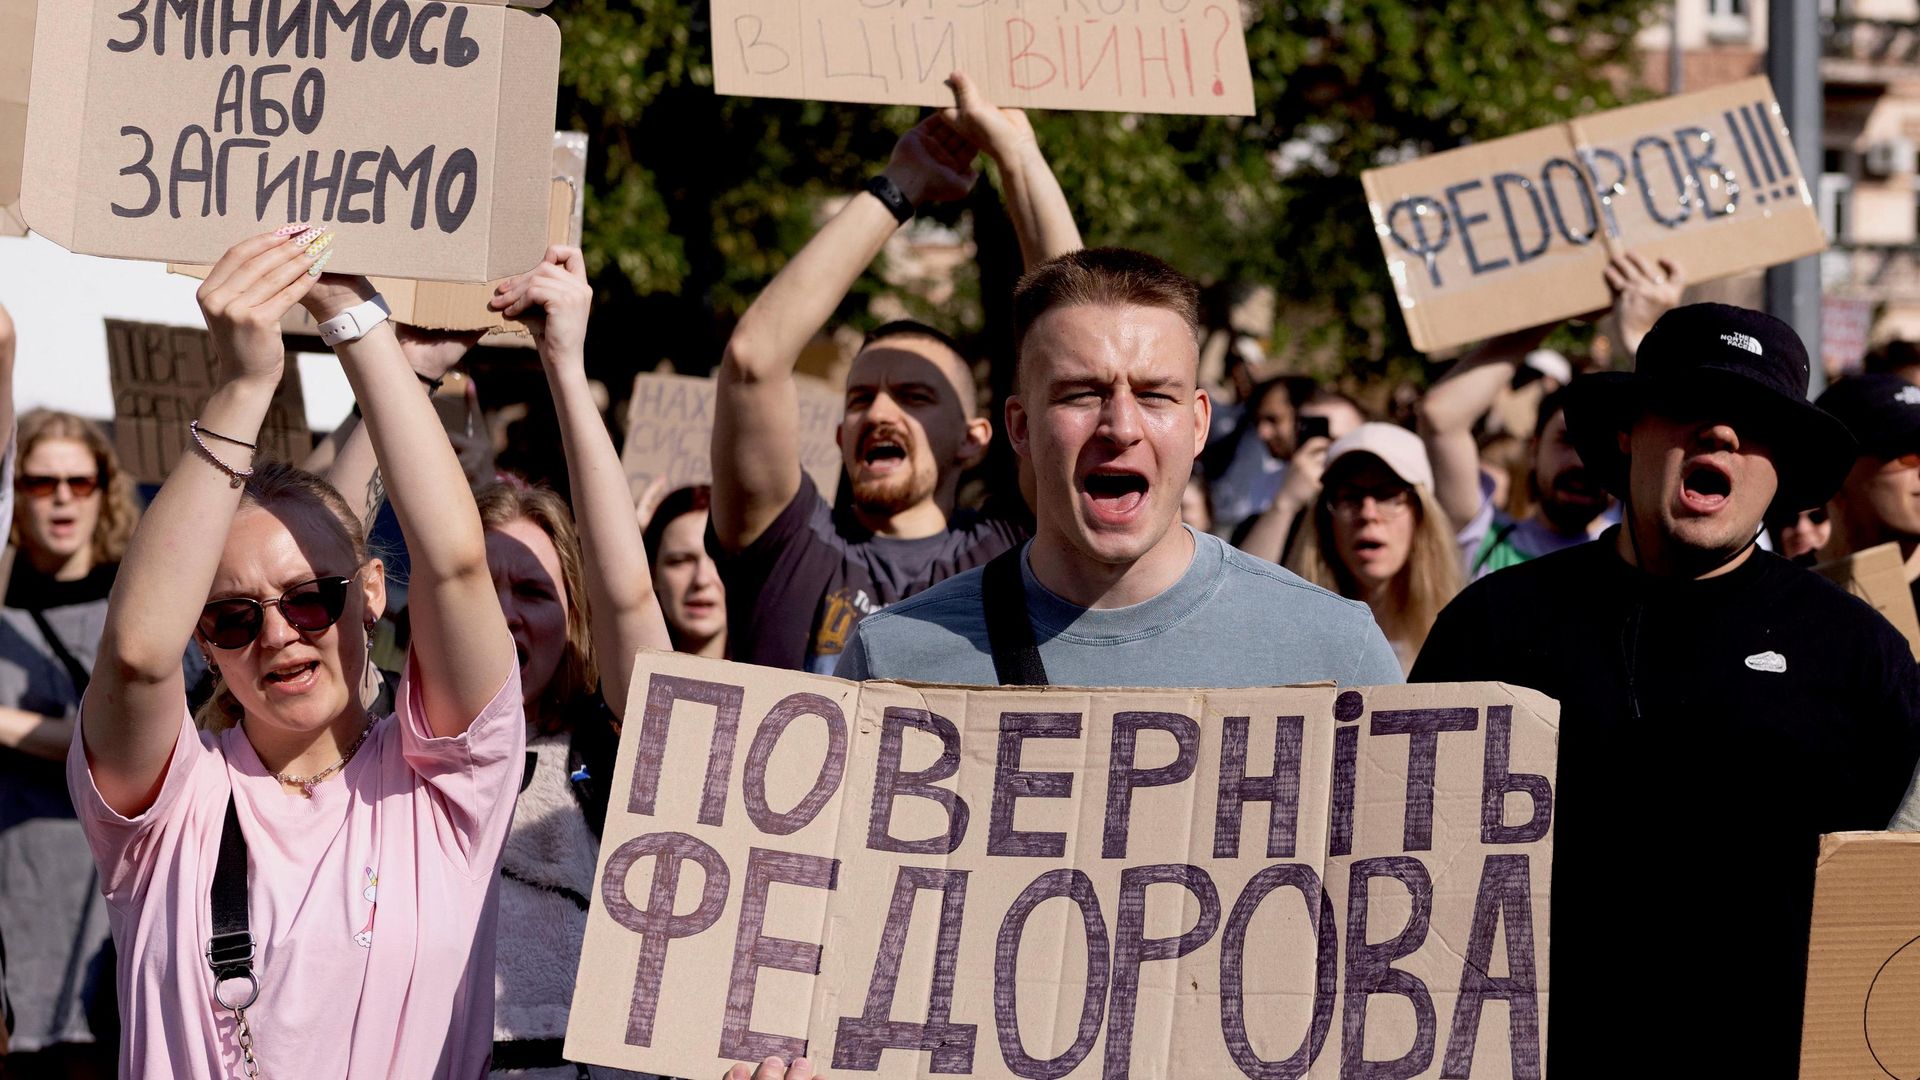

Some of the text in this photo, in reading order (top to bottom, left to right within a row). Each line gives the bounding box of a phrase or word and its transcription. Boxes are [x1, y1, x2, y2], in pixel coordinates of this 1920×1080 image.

[107, 0, 480, 67] ЗМІНИМОСЬ
[734, 14, 790, 75] В
[213, 64, 326, 137] АБО
[110, 123, 478, 234] ЗАГИНЕМО
[1720, 334, 1750, 346] NORTH
[1727, 340, 1749, 351] FACE
[1733, 331, 1750, 341] THE
[600, 831, 1541, 1080] ФЕДОРОВА
